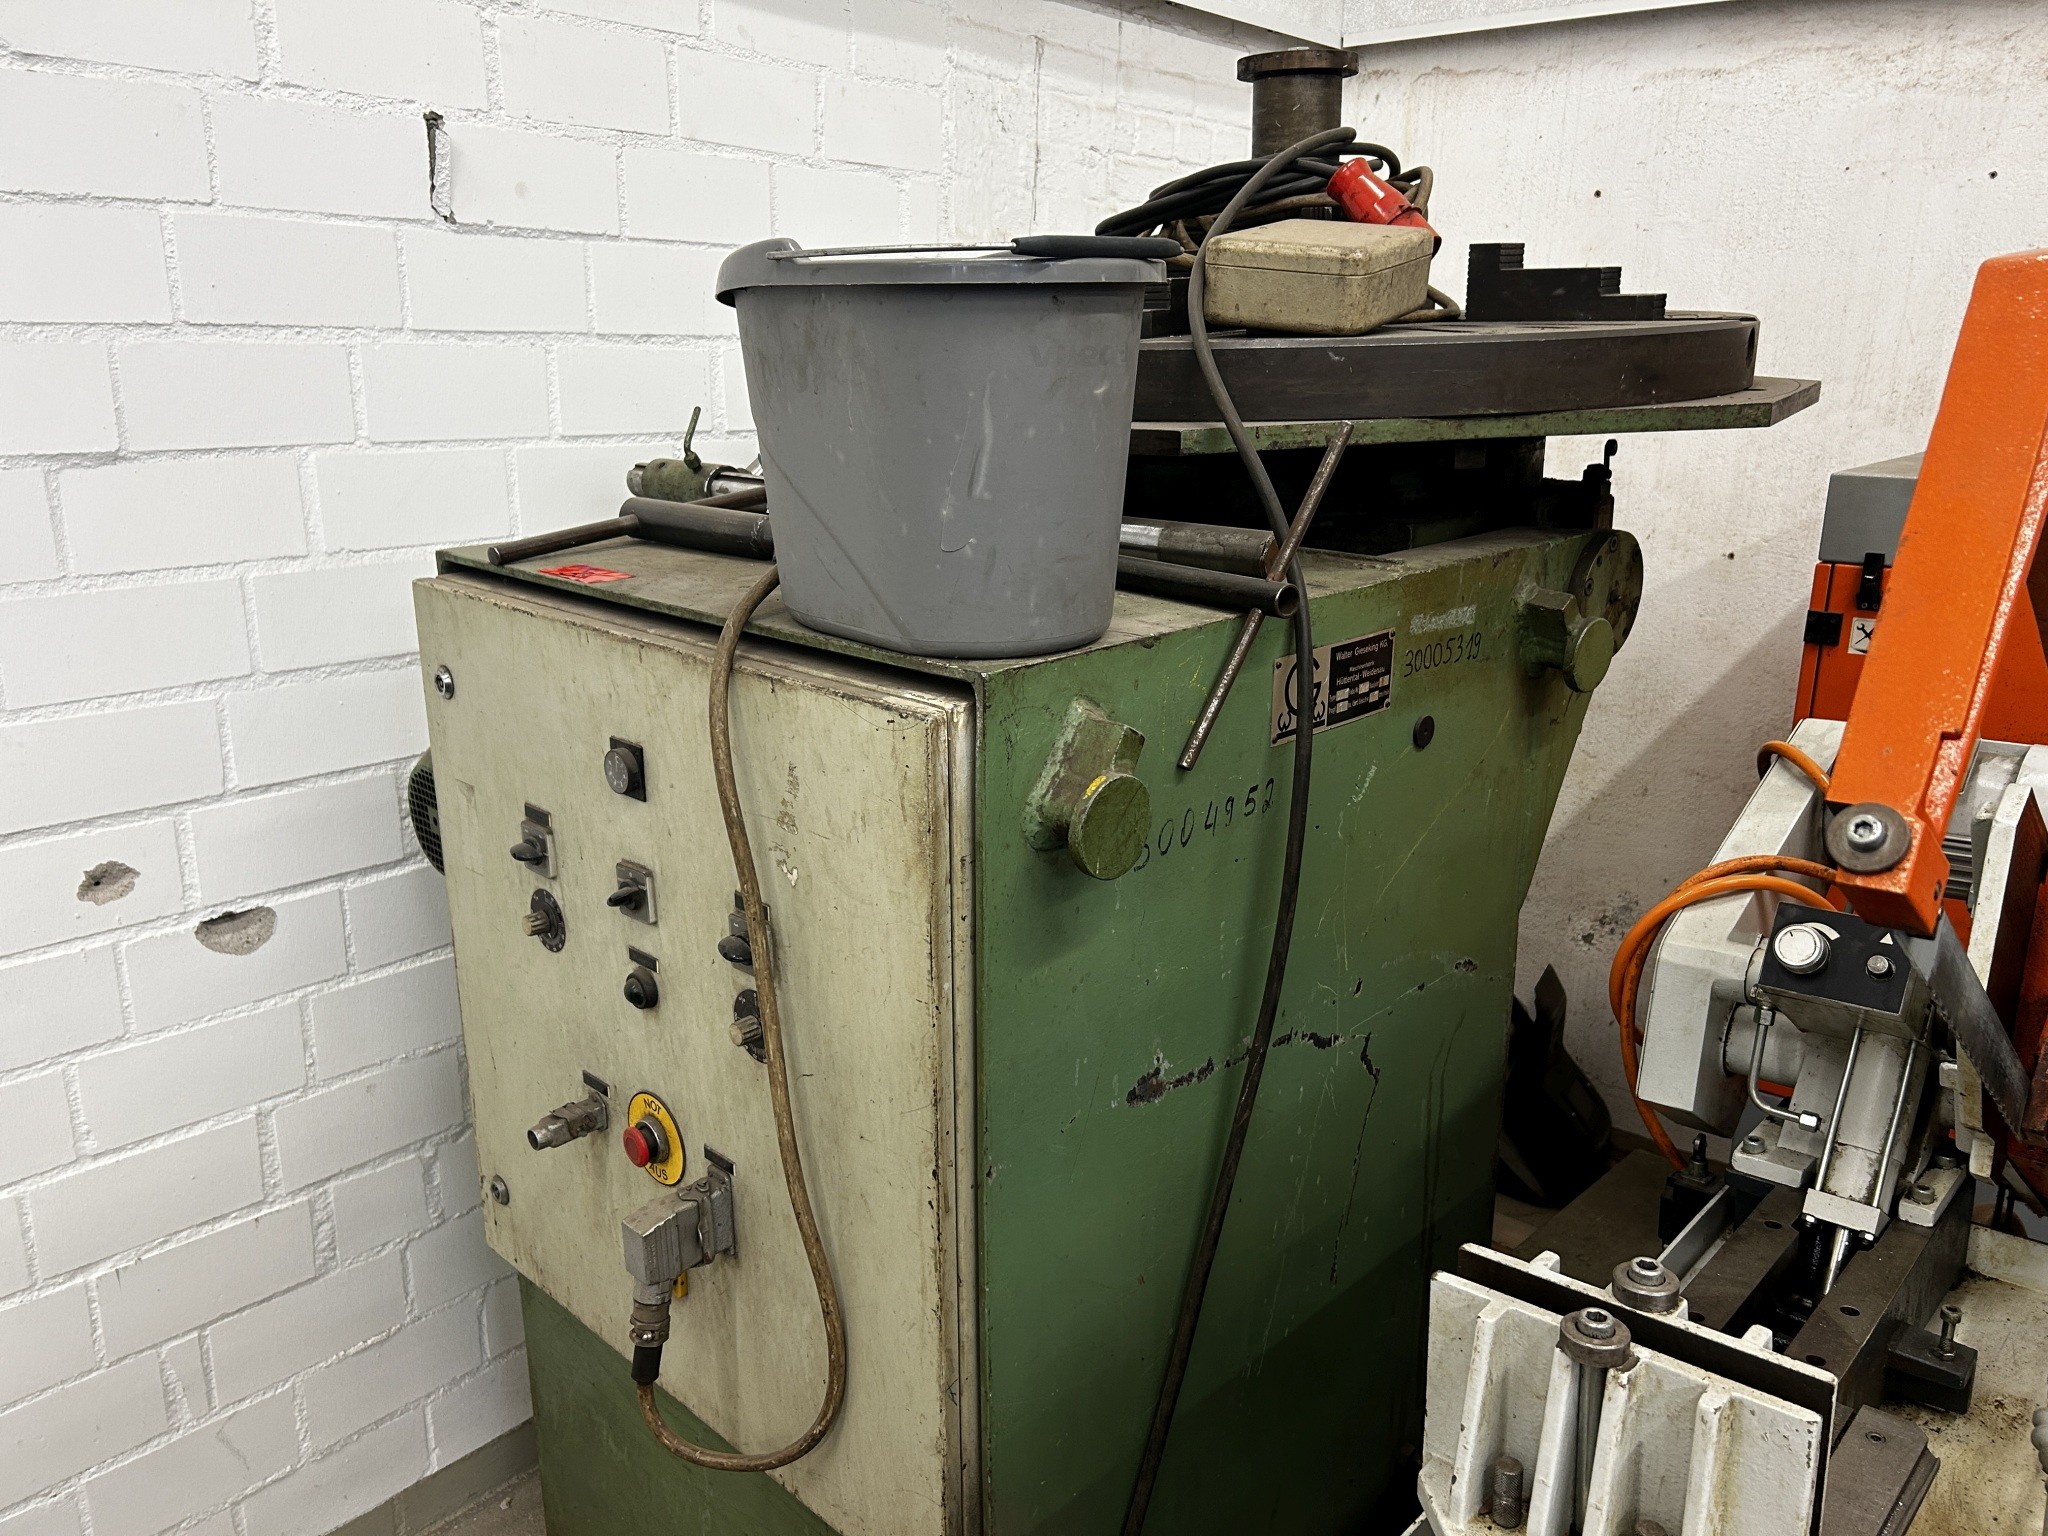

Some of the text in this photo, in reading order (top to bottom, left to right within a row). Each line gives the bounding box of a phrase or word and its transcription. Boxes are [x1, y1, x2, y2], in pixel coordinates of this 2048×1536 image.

[1336, 650, 1353, 661] Walter
[1404, 632, 1481, 677] 30005319
[643, 1097, 662, 1115] NOT
[649, 1163, 668, 1181] AUS
